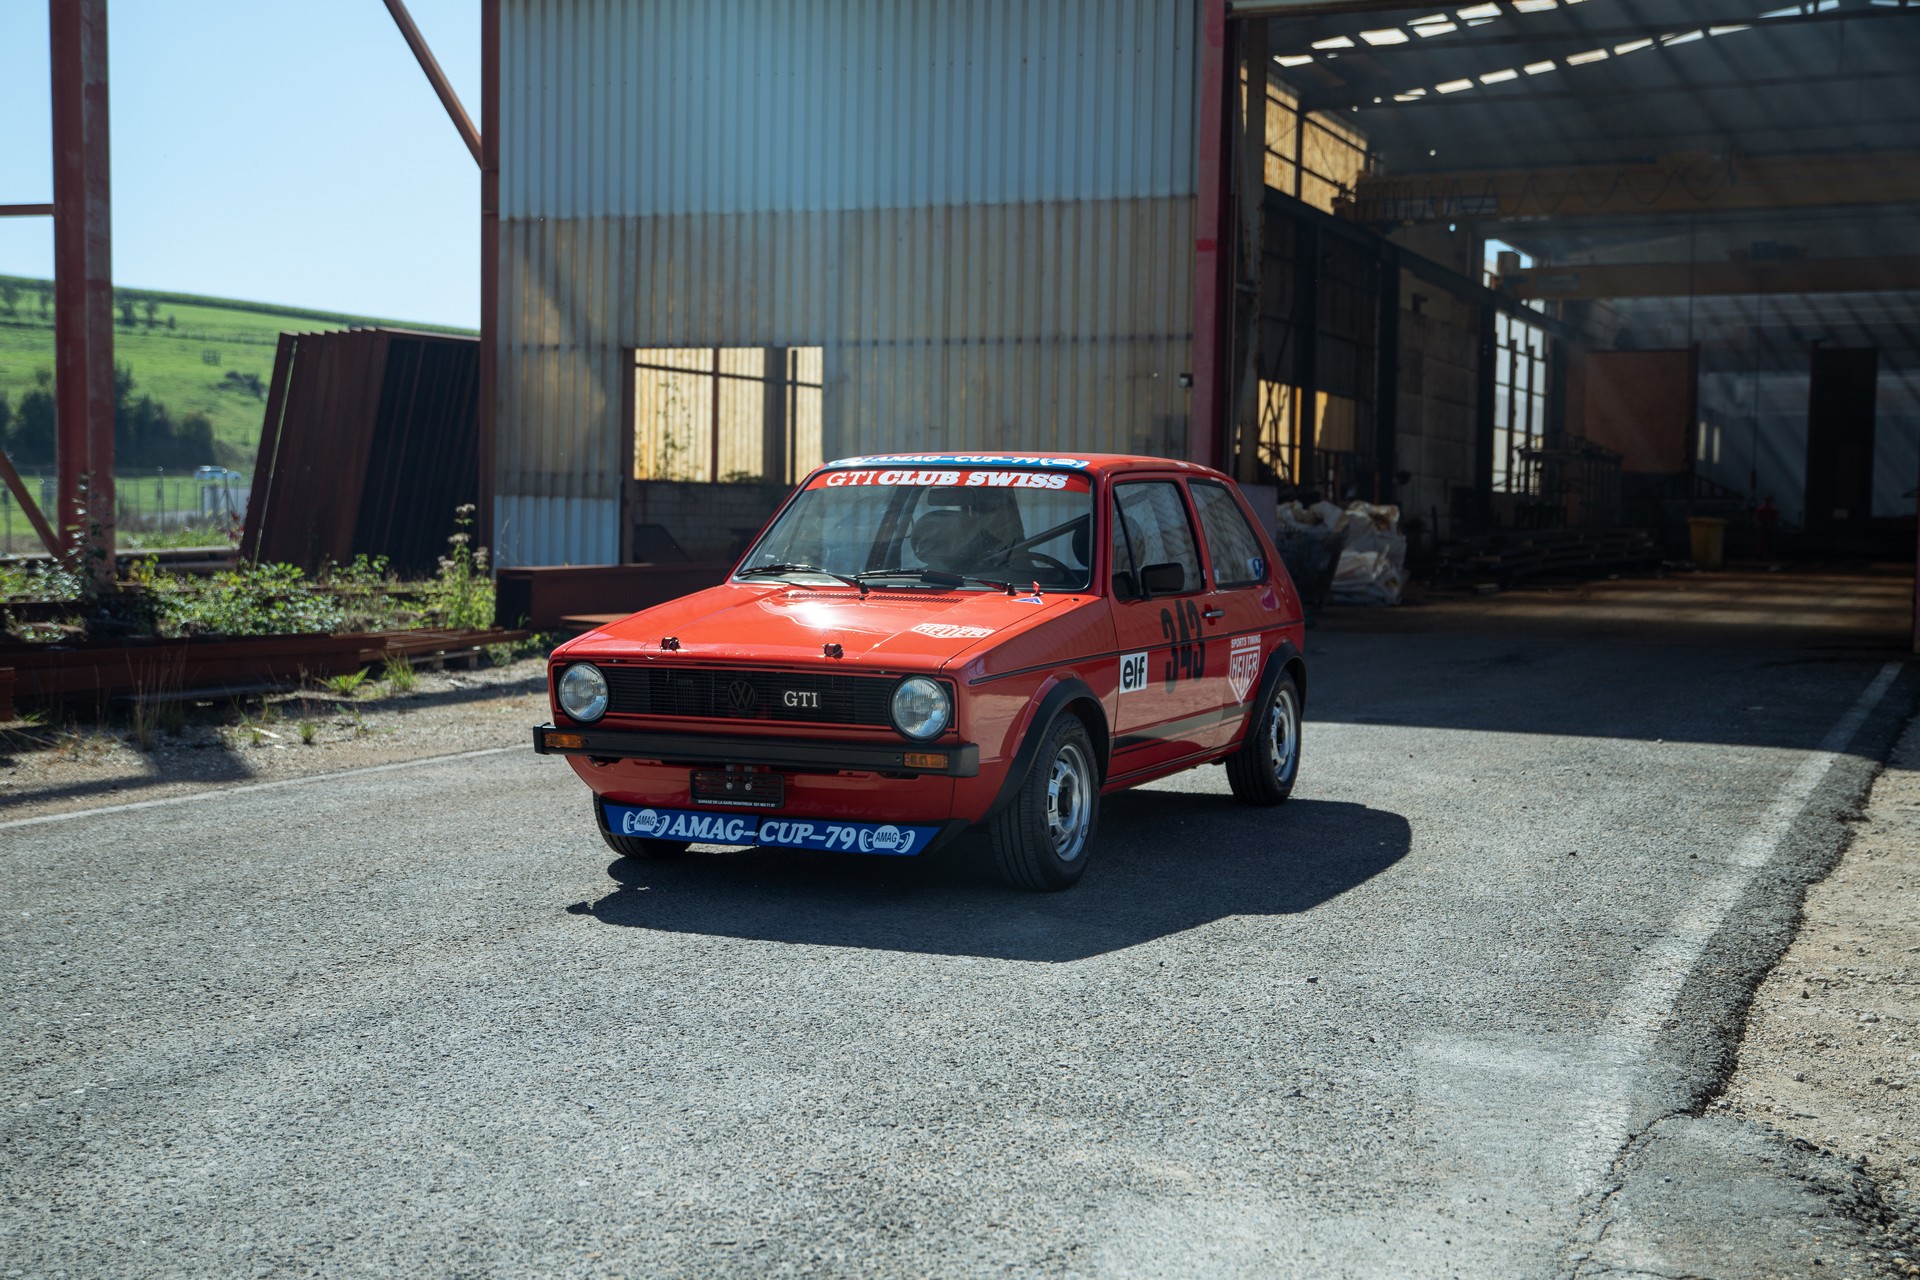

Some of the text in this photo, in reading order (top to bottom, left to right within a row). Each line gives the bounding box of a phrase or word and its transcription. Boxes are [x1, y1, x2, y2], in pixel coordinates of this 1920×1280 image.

[826, 470, 1070, 489] GTI CLUB SWISS
[1160, 599, 1205, 695] 343
[1231, 636, 1247, 648] SPORTS
[1122, 656, 1145, 690] elf
[1231, 652, 1258, 696] HEUER
[784, 691, 818, 708] GTI
[635, 815, 656, 827] AMAG
[874, 832, 898, 843] AMAG
